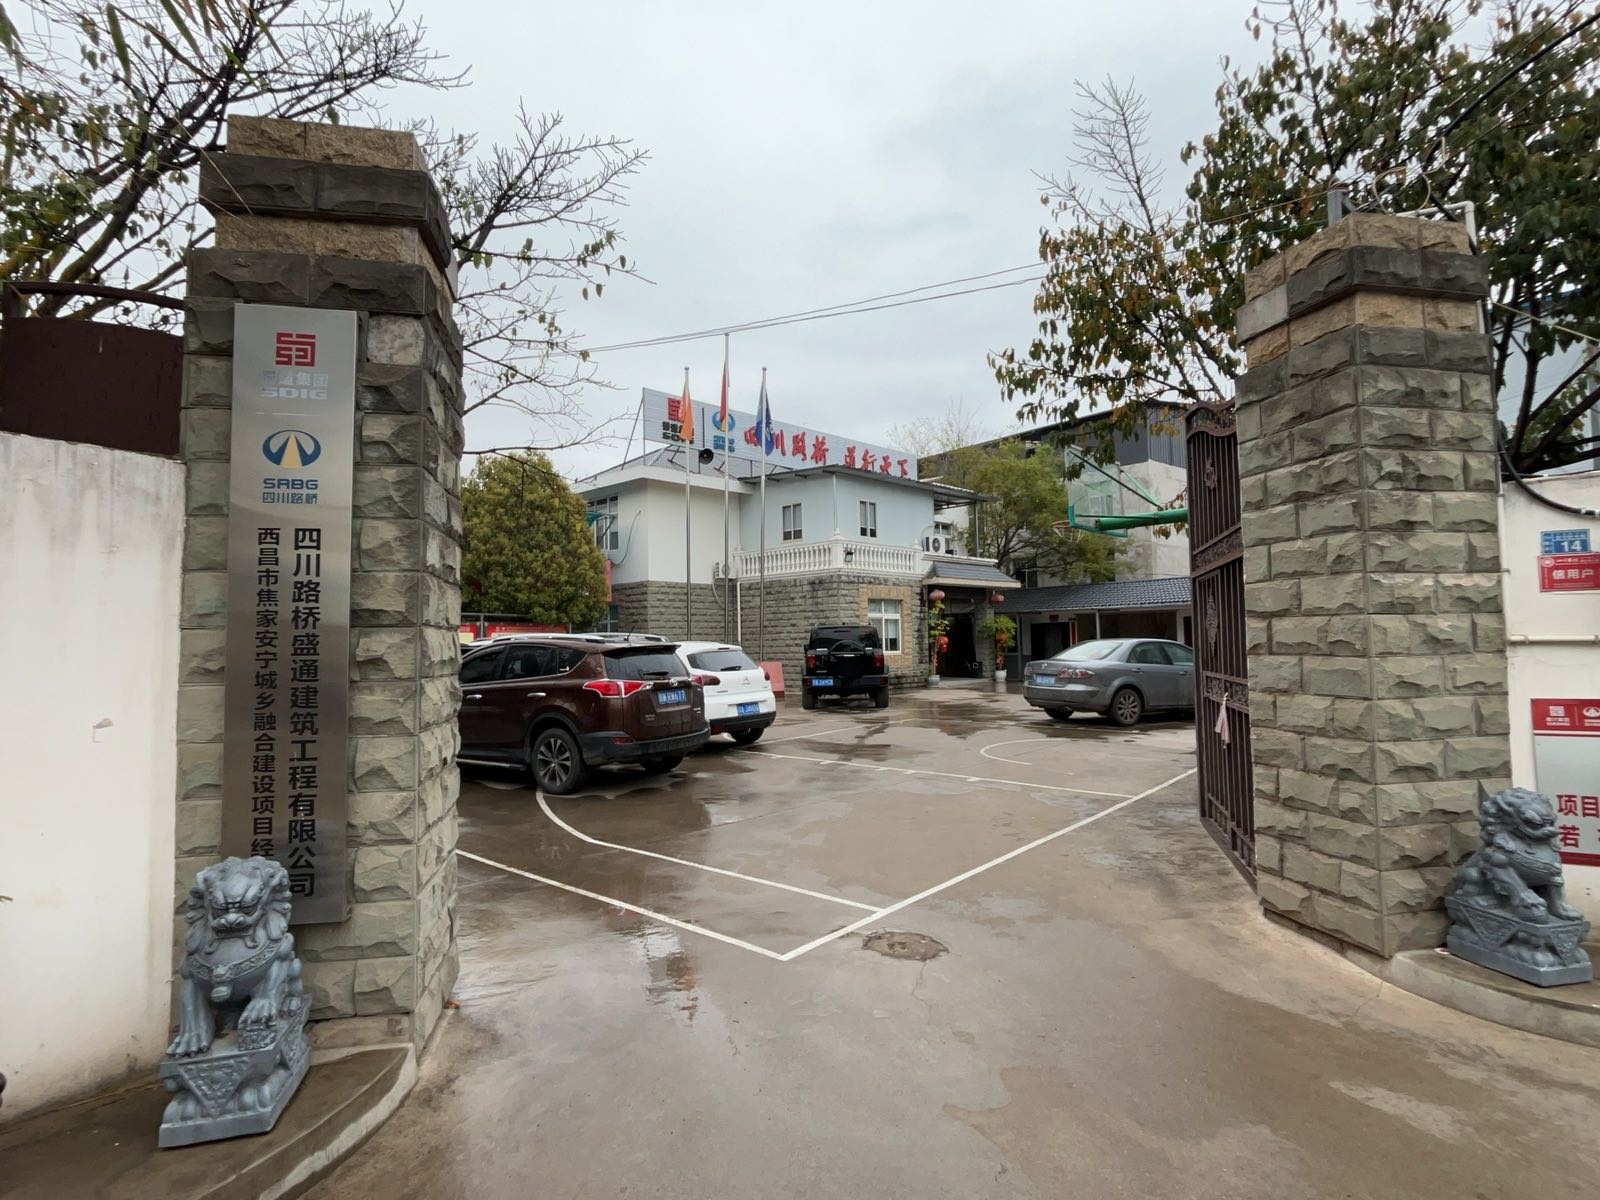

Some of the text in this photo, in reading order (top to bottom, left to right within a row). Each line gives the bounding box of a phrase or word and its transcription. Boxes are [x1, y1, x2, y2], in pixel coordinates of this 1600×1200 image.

[262, 387, 328, 400] SDIG
[262, 492, 318, 505] 四川路桥
[1561, 540, 1582, 552] 14
[288, 527, 321, 897] 四川路桥盛通建筑工程有限公司
[1556, 794, 1599, 818] 项目
